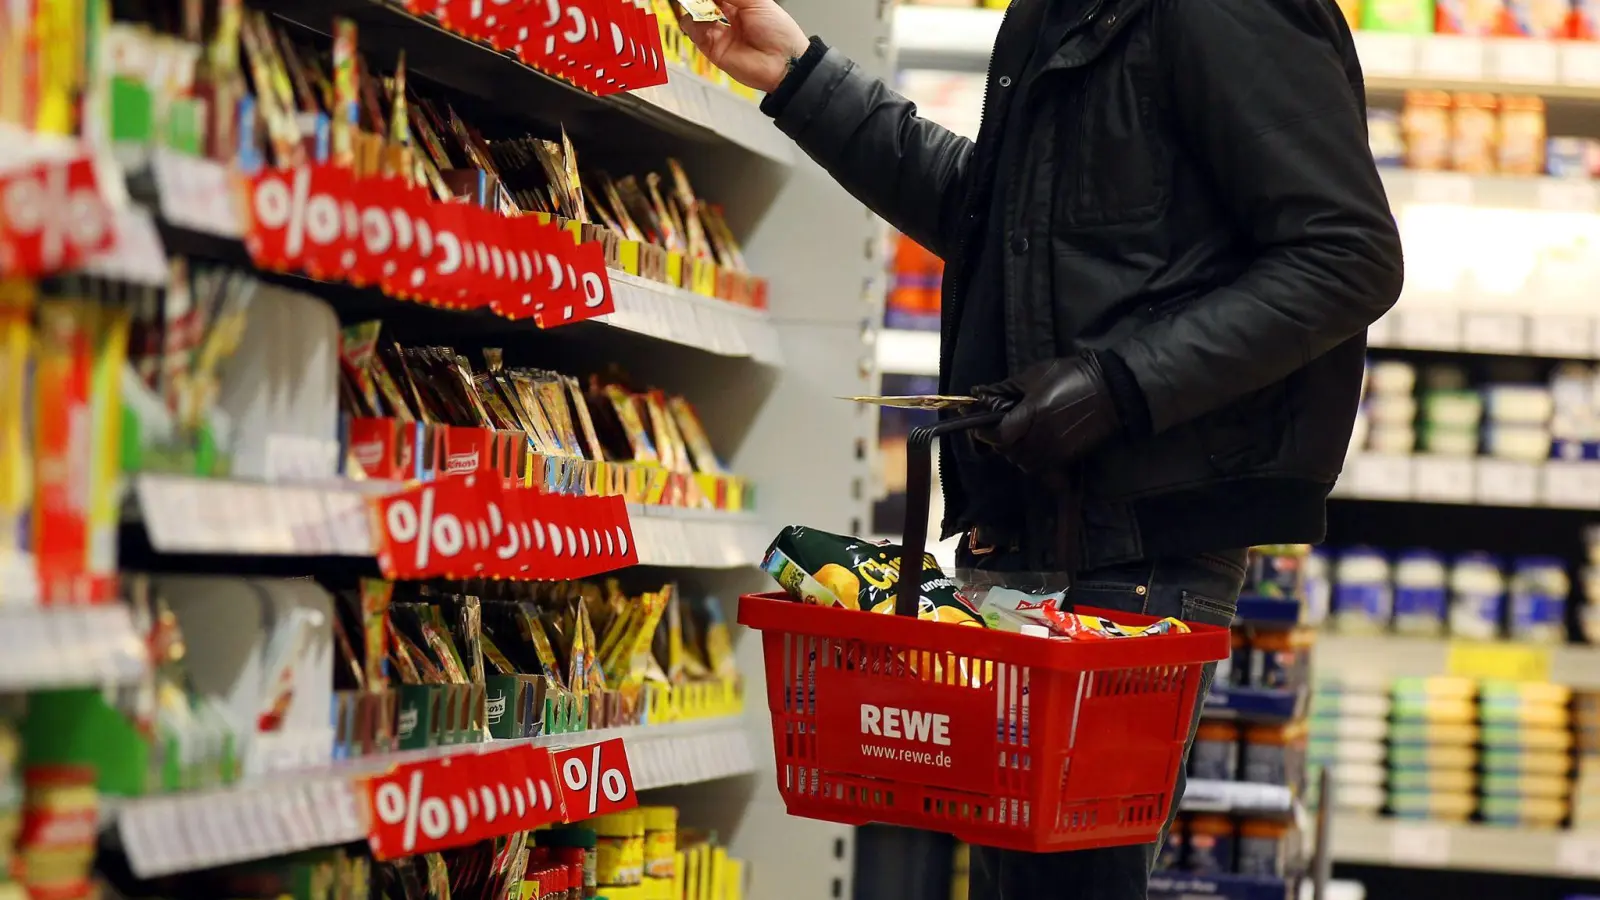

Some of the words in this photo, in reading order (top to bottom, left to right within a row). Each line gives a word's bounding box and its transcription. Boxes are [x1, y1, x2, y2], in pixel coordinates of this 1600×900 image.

[255, 164, 341, 257] %
[387, 487, 463, 569] %
[860, 703, 951, 746] REWE
[861, 744, 951, 768] www.rewe.de
[376, 770, 450, 851] %
[563, 745, 627, 814] %
